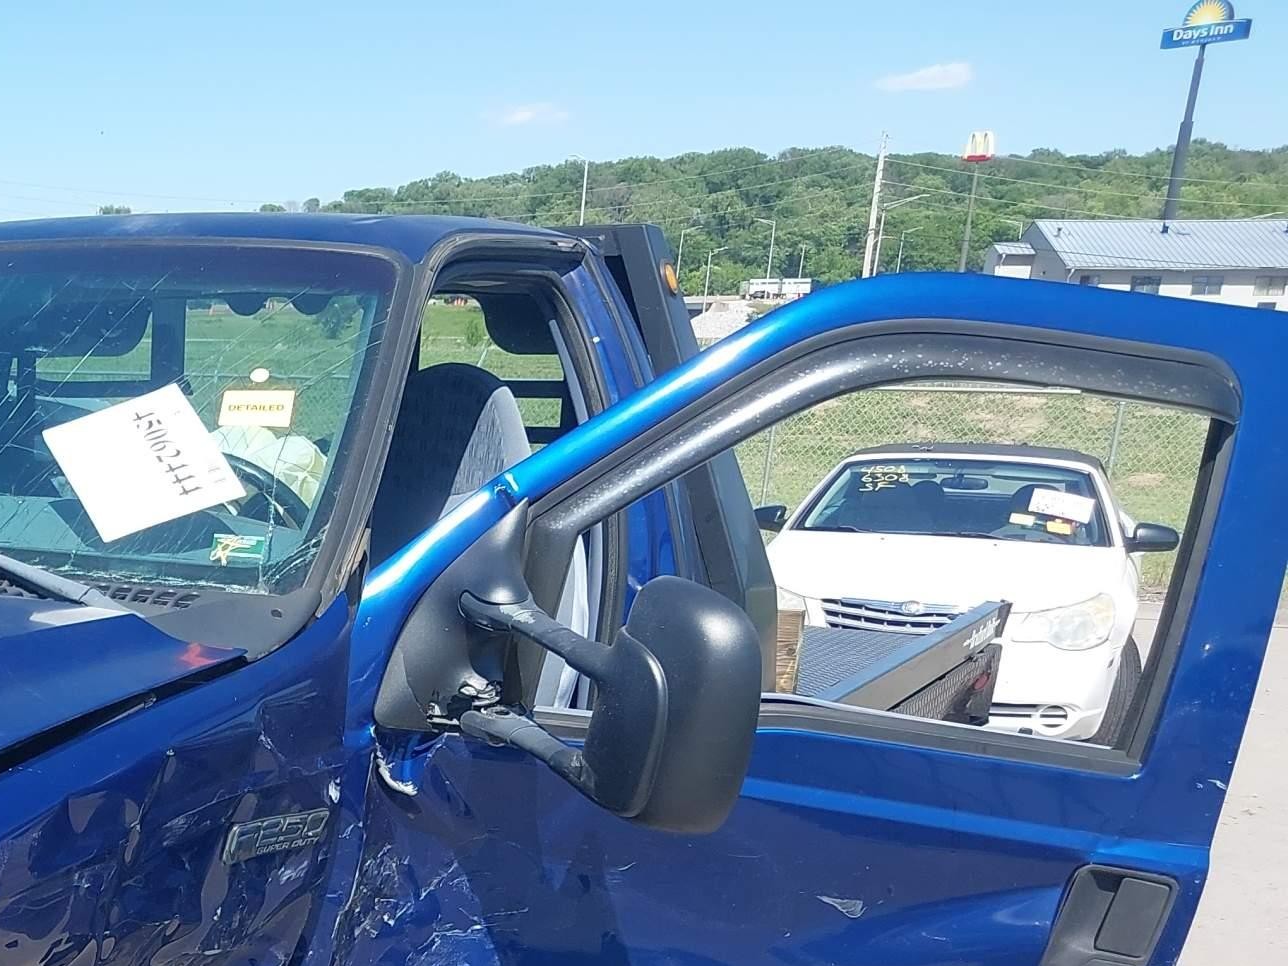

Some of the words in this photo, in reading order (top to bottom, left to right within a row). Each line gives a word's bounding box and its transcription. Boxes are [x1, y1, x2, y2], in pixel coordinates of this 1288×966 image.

[1172, 27, 1208, 41] Days
[1209, 24, 1234, 36] Inn
[228, 403, 285, 412] DETAILED
[133, 411, 203, 496] 45062444
[257, 842, 290, 855] SUPER
[291, 836, 320, 848] DUTY
